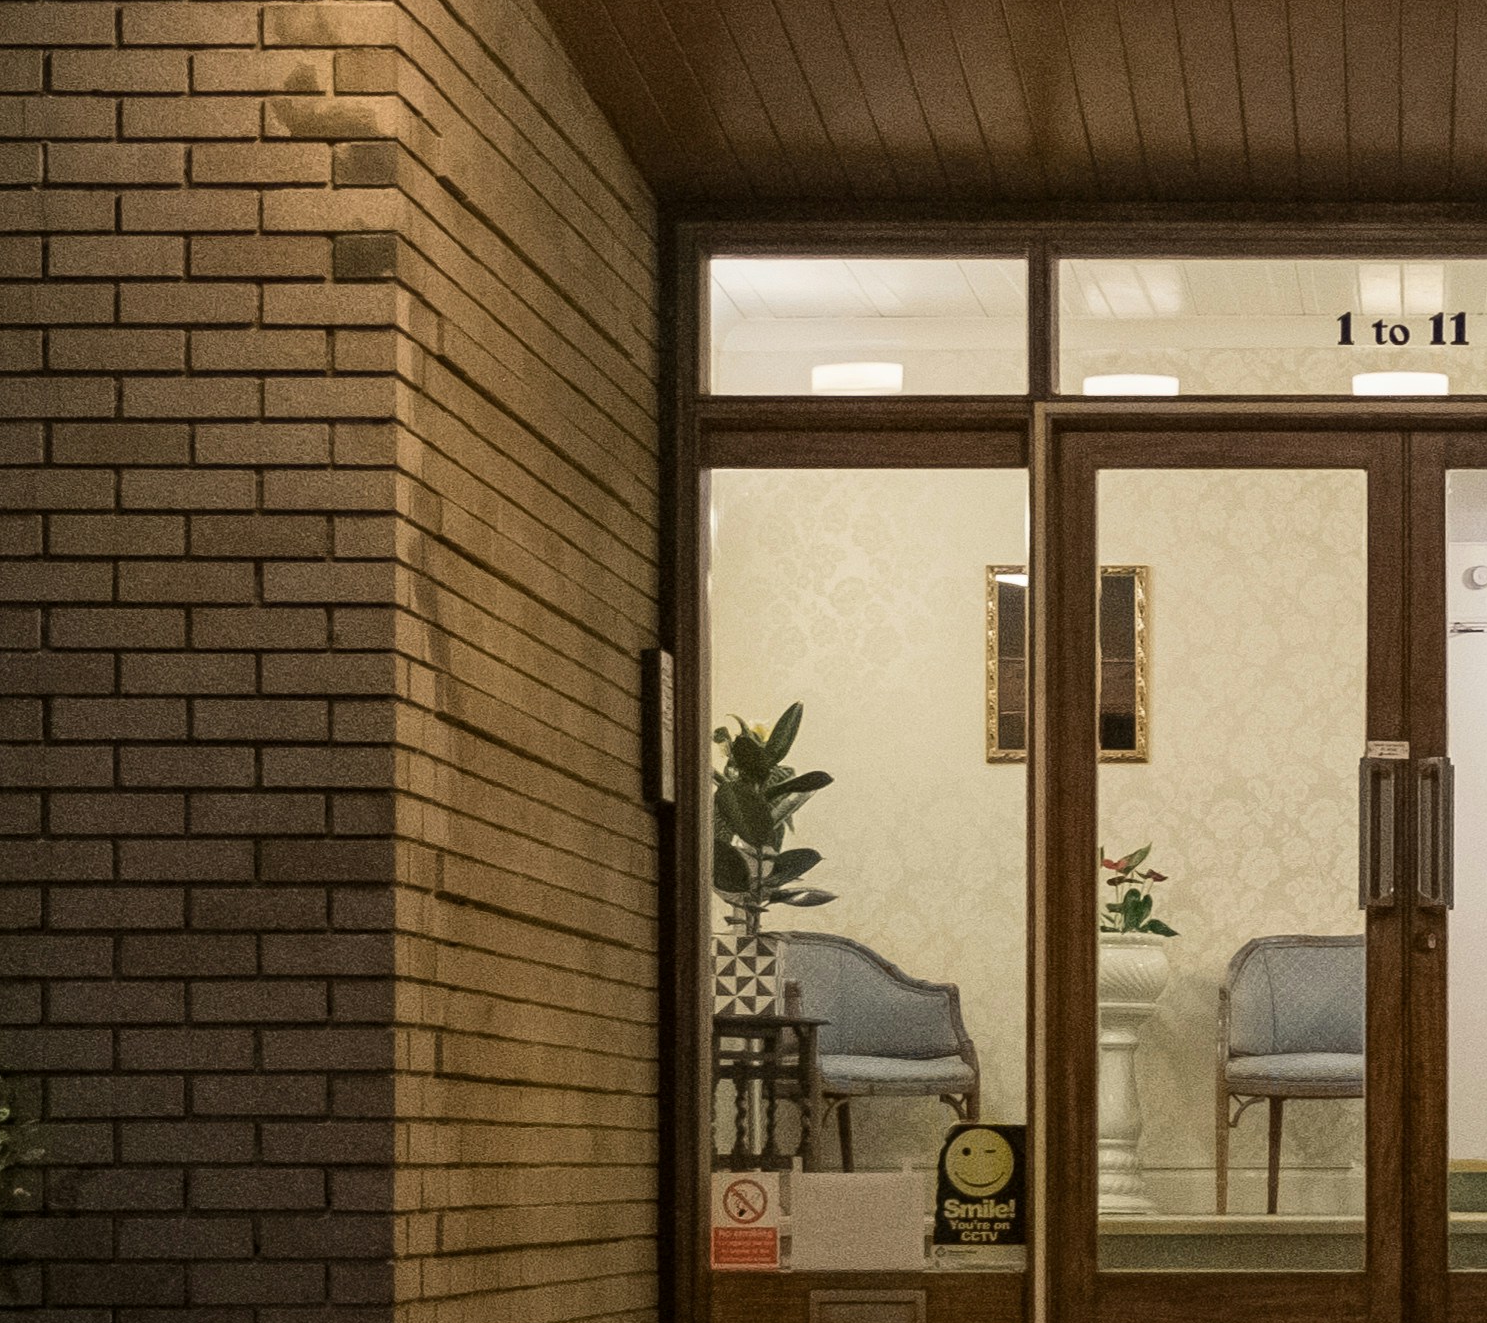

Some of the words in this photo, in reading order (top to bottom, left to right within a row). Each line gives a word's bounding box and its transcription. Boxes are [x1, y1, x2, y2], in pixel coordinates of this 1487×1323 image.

[1337, 311, 1355, 346] 1
[1371, 318, 1410, 346] to
[1428, 311, 1469, 346] 11
[943, 1198, 1017, 1219] Smile!
[949, 1219, 991, 1230] You're
[993, 1221, 1011, 1230] on
[960, 1231, 999, 1242] CCTV
